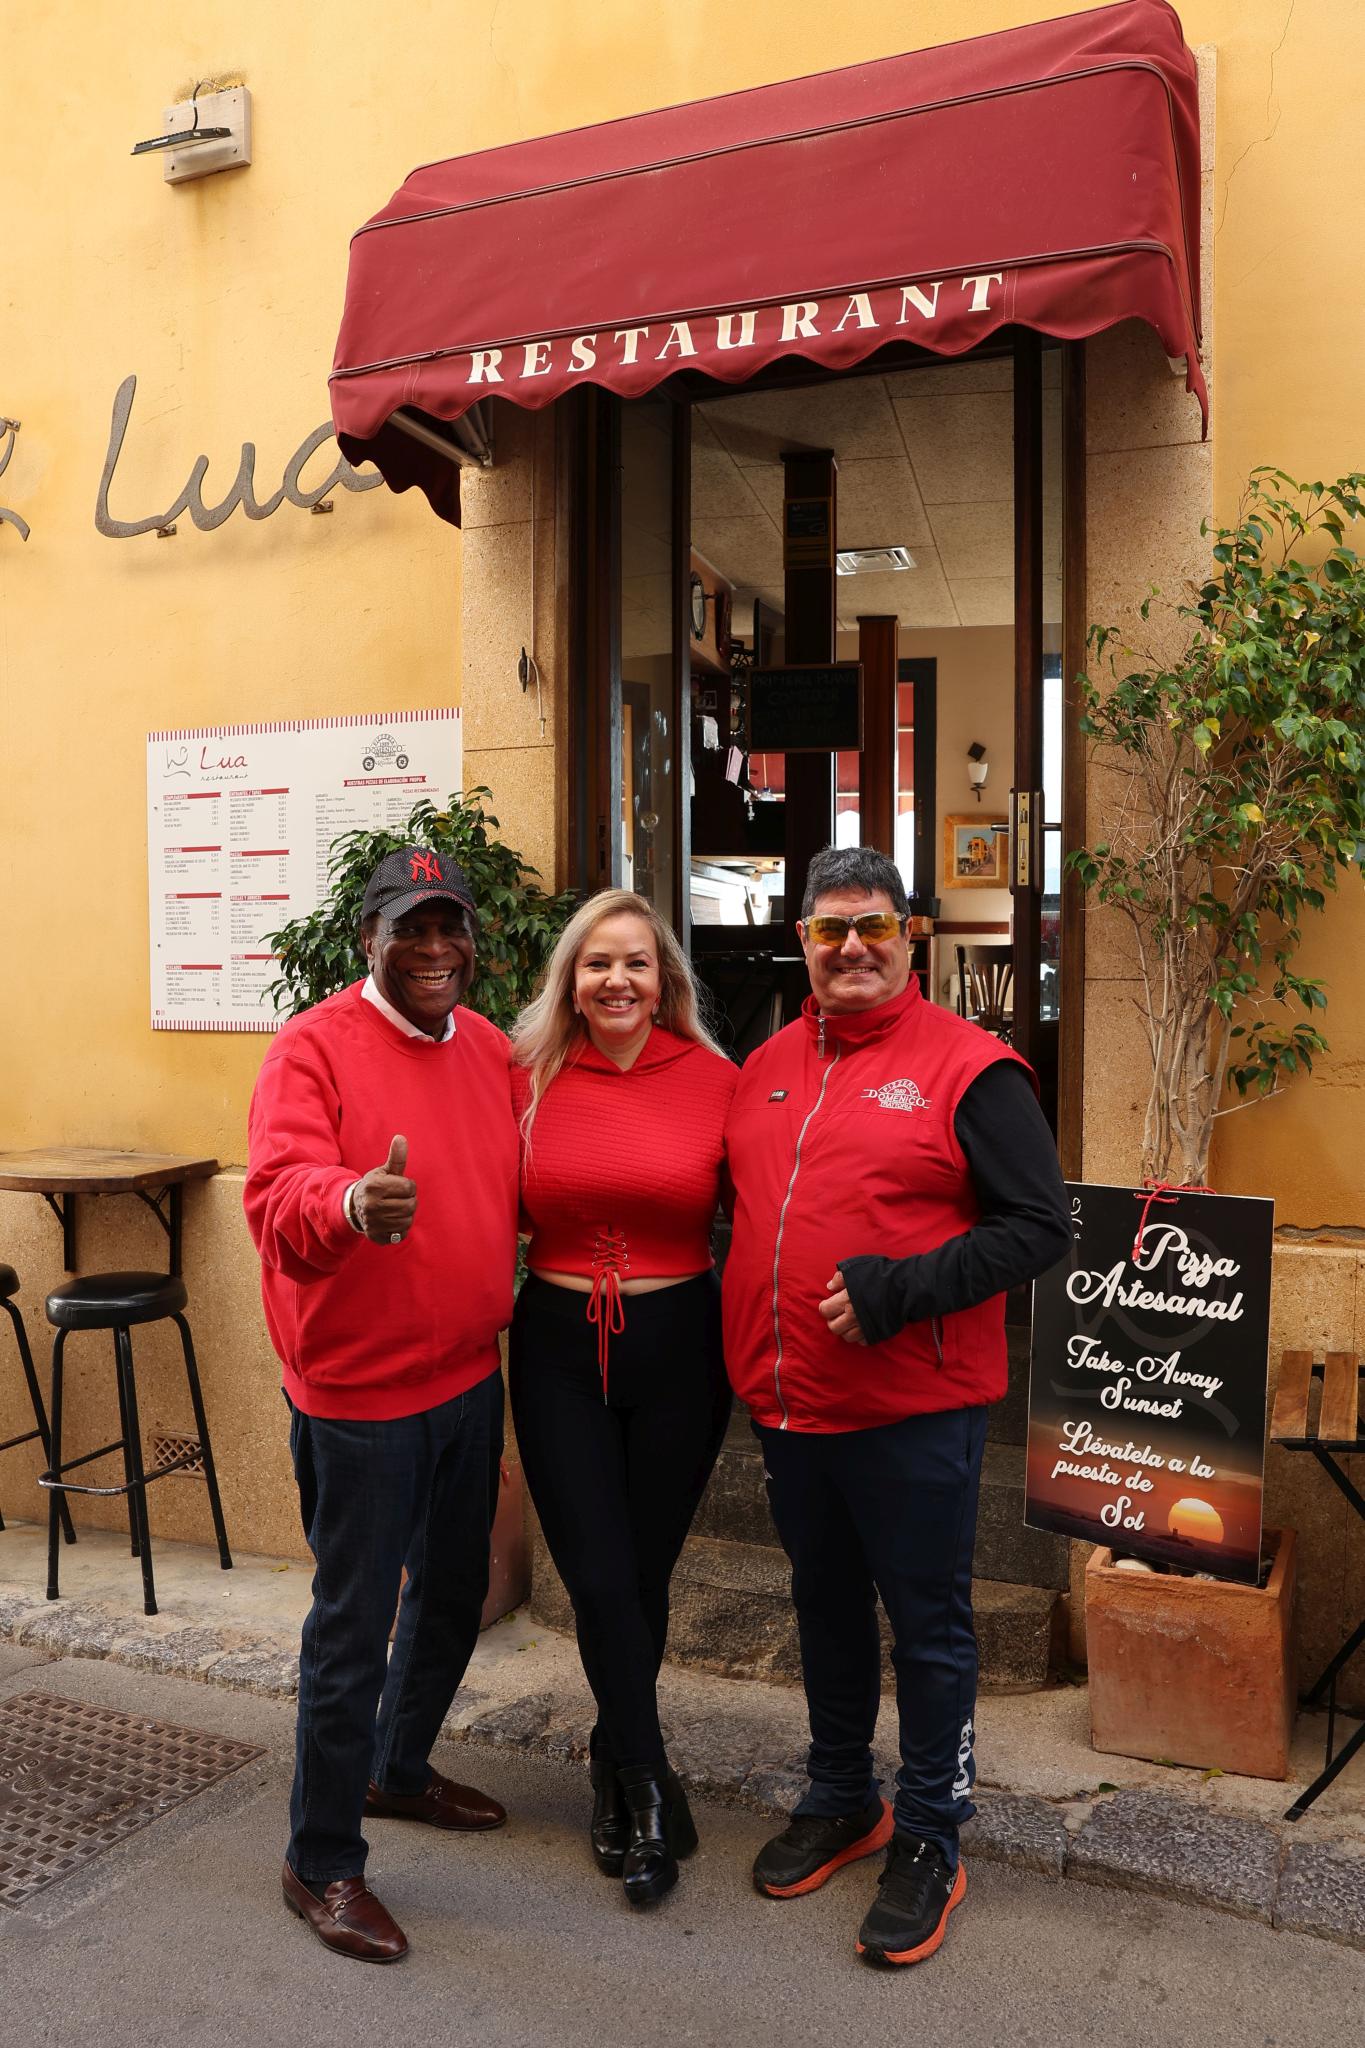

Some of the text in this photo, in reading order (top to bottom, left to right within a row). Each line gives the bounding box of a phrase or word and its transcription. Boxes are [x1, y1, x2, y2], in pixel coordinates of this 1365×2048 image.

[466, 272, 1003, 384] RESTAURANT
[95, 374, 385, 539] Lua
[200, 746, 248, 770] Lua
[409, 851, 444, 882] NY
[868, 1089, 926, 1107] DOMENICO
[883, 1079, 916, 1095] PIZZERIA
[1132, 1223, 1240, 1287] Pizza
[1066, 1260, 1244, 1322] Artesanal
[1100, 1376, 1184, 1419] Sunset
[1058, 1420, 1216, 1479] Llévatela a la
[1051, 1459, 1154, 1494] puesta de
[1100, 1495, 1145, 1532] Sol
